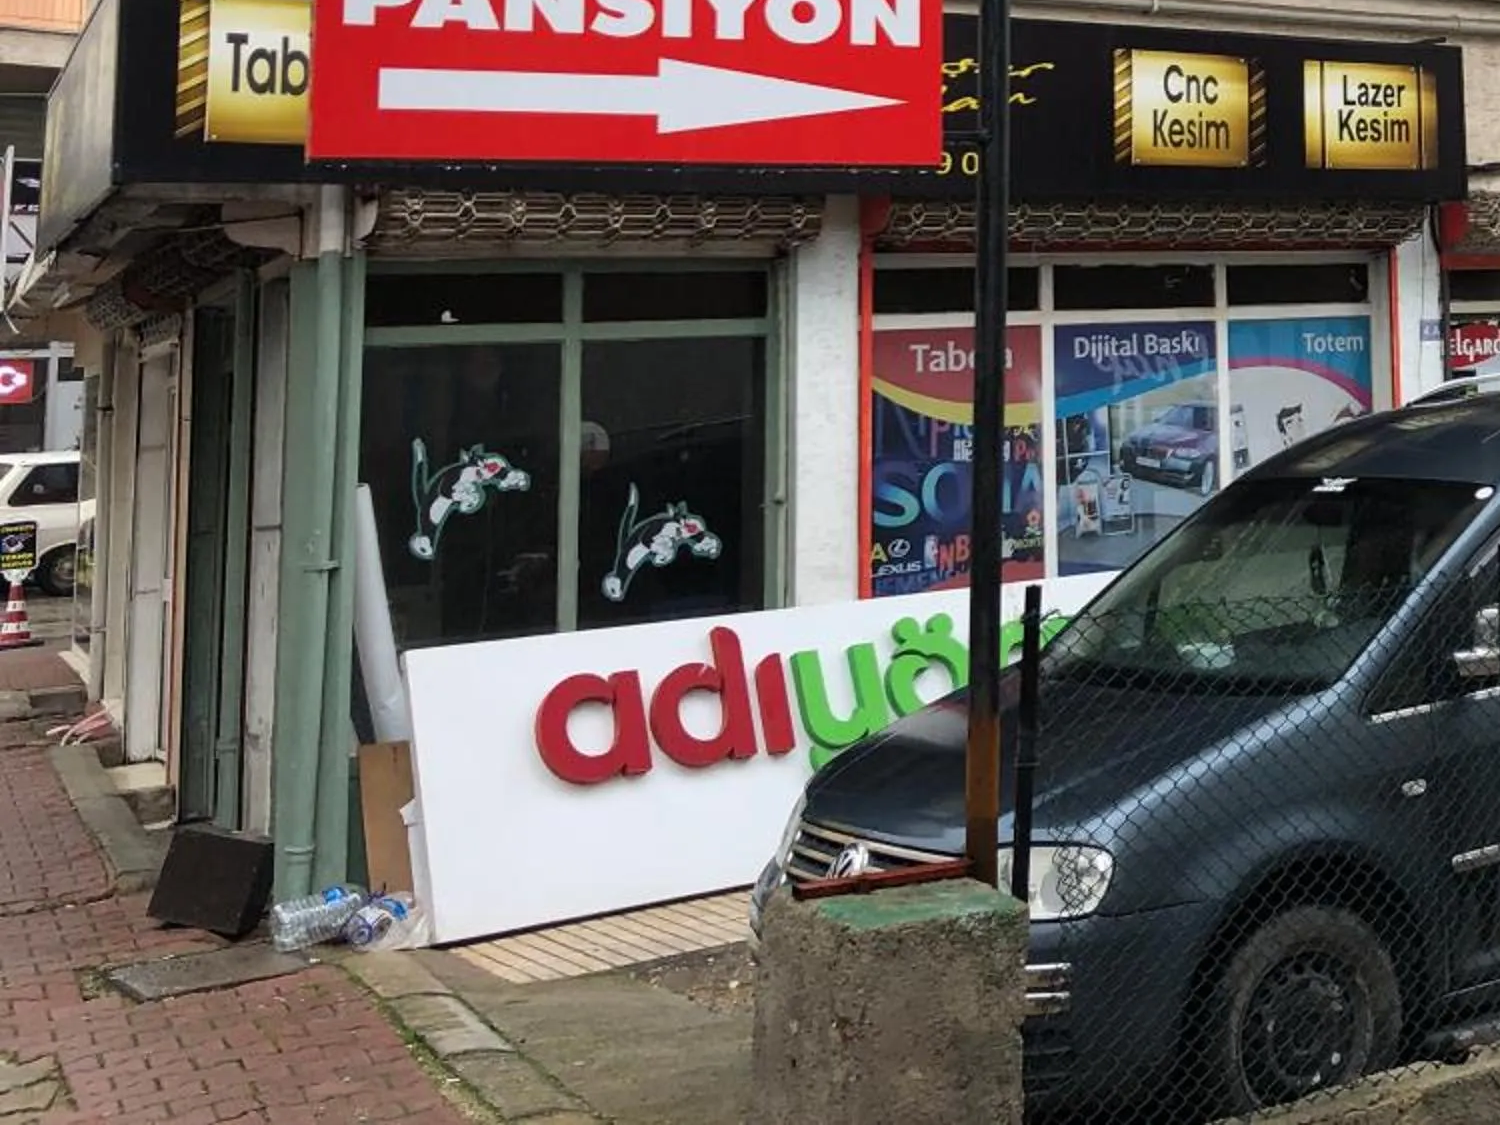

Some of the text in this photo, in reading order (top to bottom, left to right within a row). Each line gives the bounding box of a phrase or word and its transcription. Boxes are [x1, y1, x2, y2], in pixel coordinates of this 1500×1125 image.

[226, 31, 309, 96] Tab
[1163, 63, 1219, 106] Cnc
[1343, 75, 1405, 108] Lazer
[1152, 109, 1230, 151] Kesim
[1338, 109, 1410, 145] Kesim
[1074, 334, 1138, 363] Dijital
[1303, 331, 1365, 354] Totem
